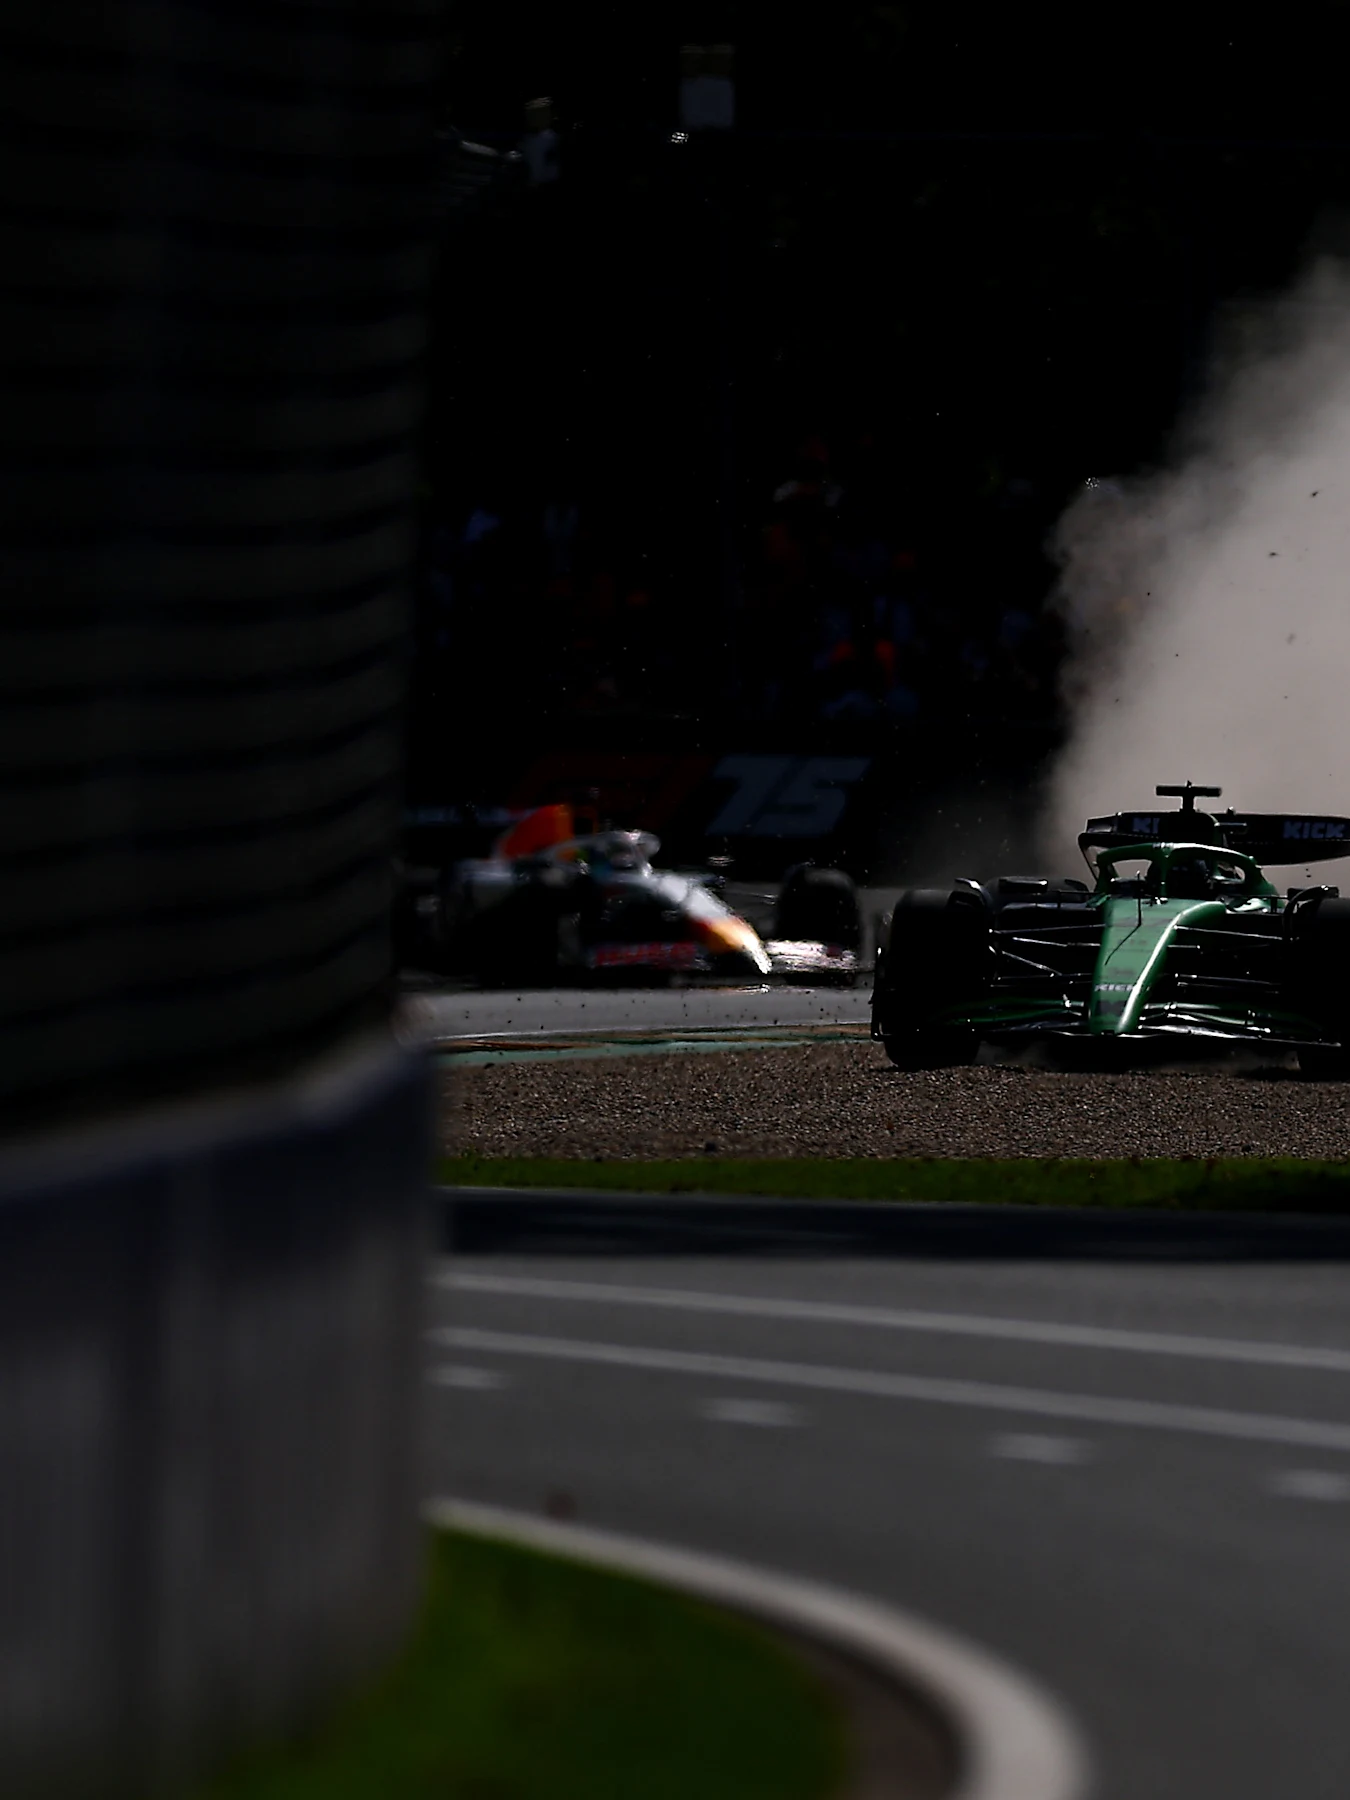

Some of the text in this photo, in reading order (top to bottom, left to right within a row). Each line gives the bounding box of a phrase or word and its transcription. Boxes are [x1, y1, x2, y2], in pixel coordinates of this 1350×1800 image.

[704, 751, 880, 839] 75
[1131, 816, 1162, 836] KI
[1281, 819, 1346, 841] KICK
